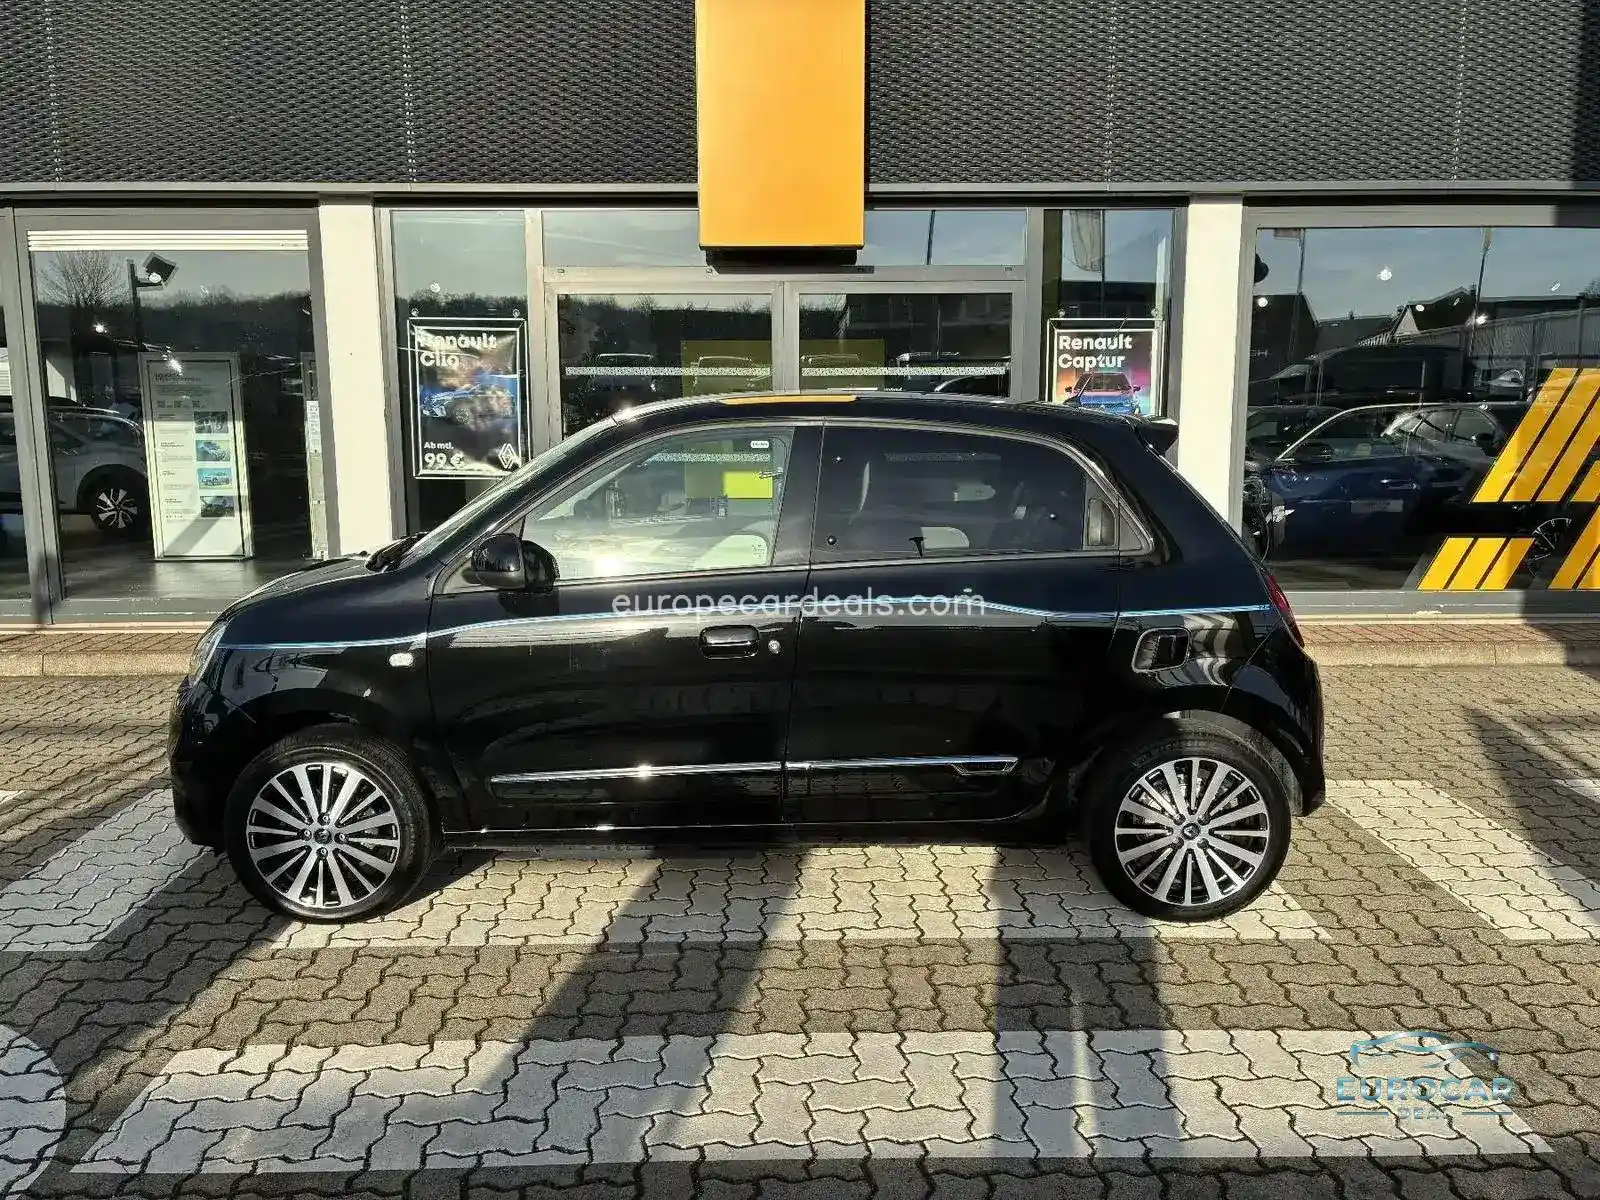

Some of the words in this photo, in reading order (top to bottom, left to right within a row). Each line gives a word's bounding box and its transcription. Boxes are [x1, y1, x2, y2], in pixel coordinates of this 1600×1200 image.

[1059, 334, 1133, 350] Renault
[420, 349, 460, 367] Clio
[1058, 353, 1126, 372] Captur
[424, 441, 436, 449] Ab
[424, 452, 447, 469] 99
